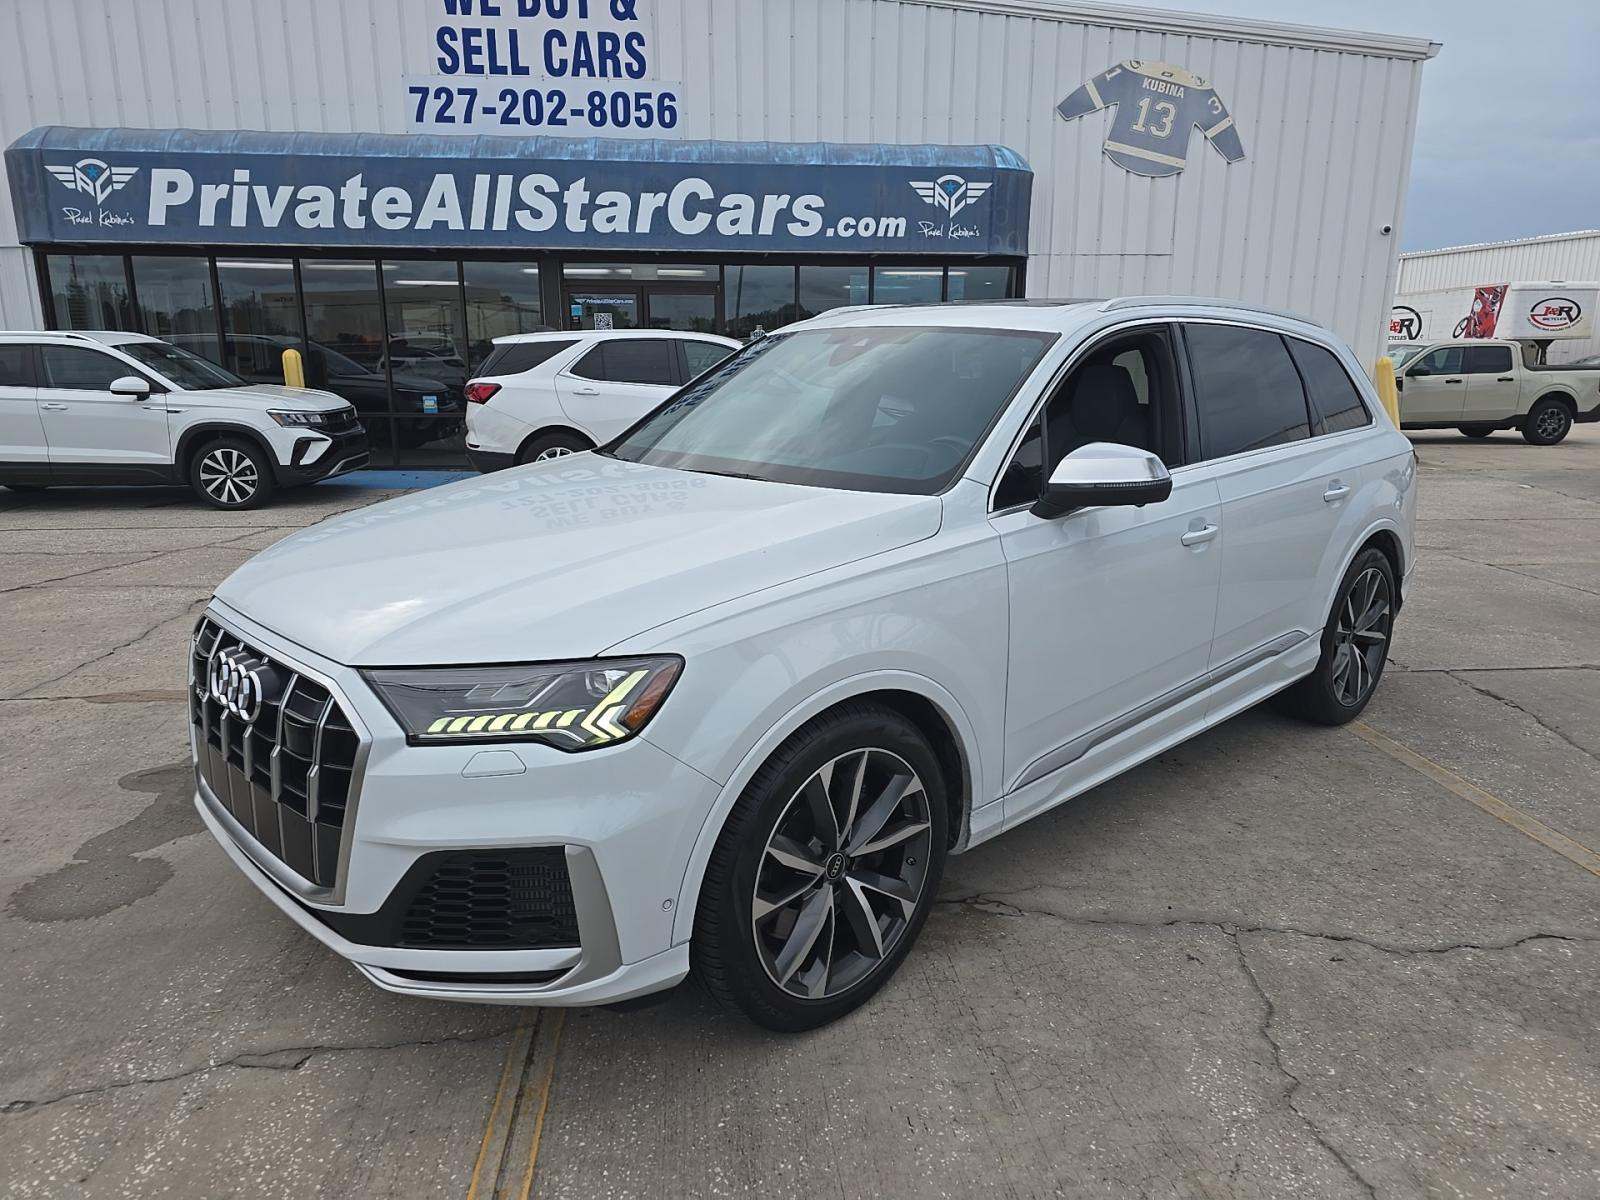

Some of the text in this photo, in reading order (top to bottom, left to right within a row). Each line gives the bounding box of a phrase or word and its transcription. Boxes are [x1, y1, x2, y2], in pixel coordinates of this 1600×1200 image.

[436, 26, 647, 79] SELL CARS
[408, 86, 678, 129] 727-202-8056
[1142, 76, 1185, 99] KUBINA
[1131, 96, 1177, 138] 13
[147, 168, 907, 238] PrivateAllStarCars.com
[1390, 317, 1415, 340] &R
